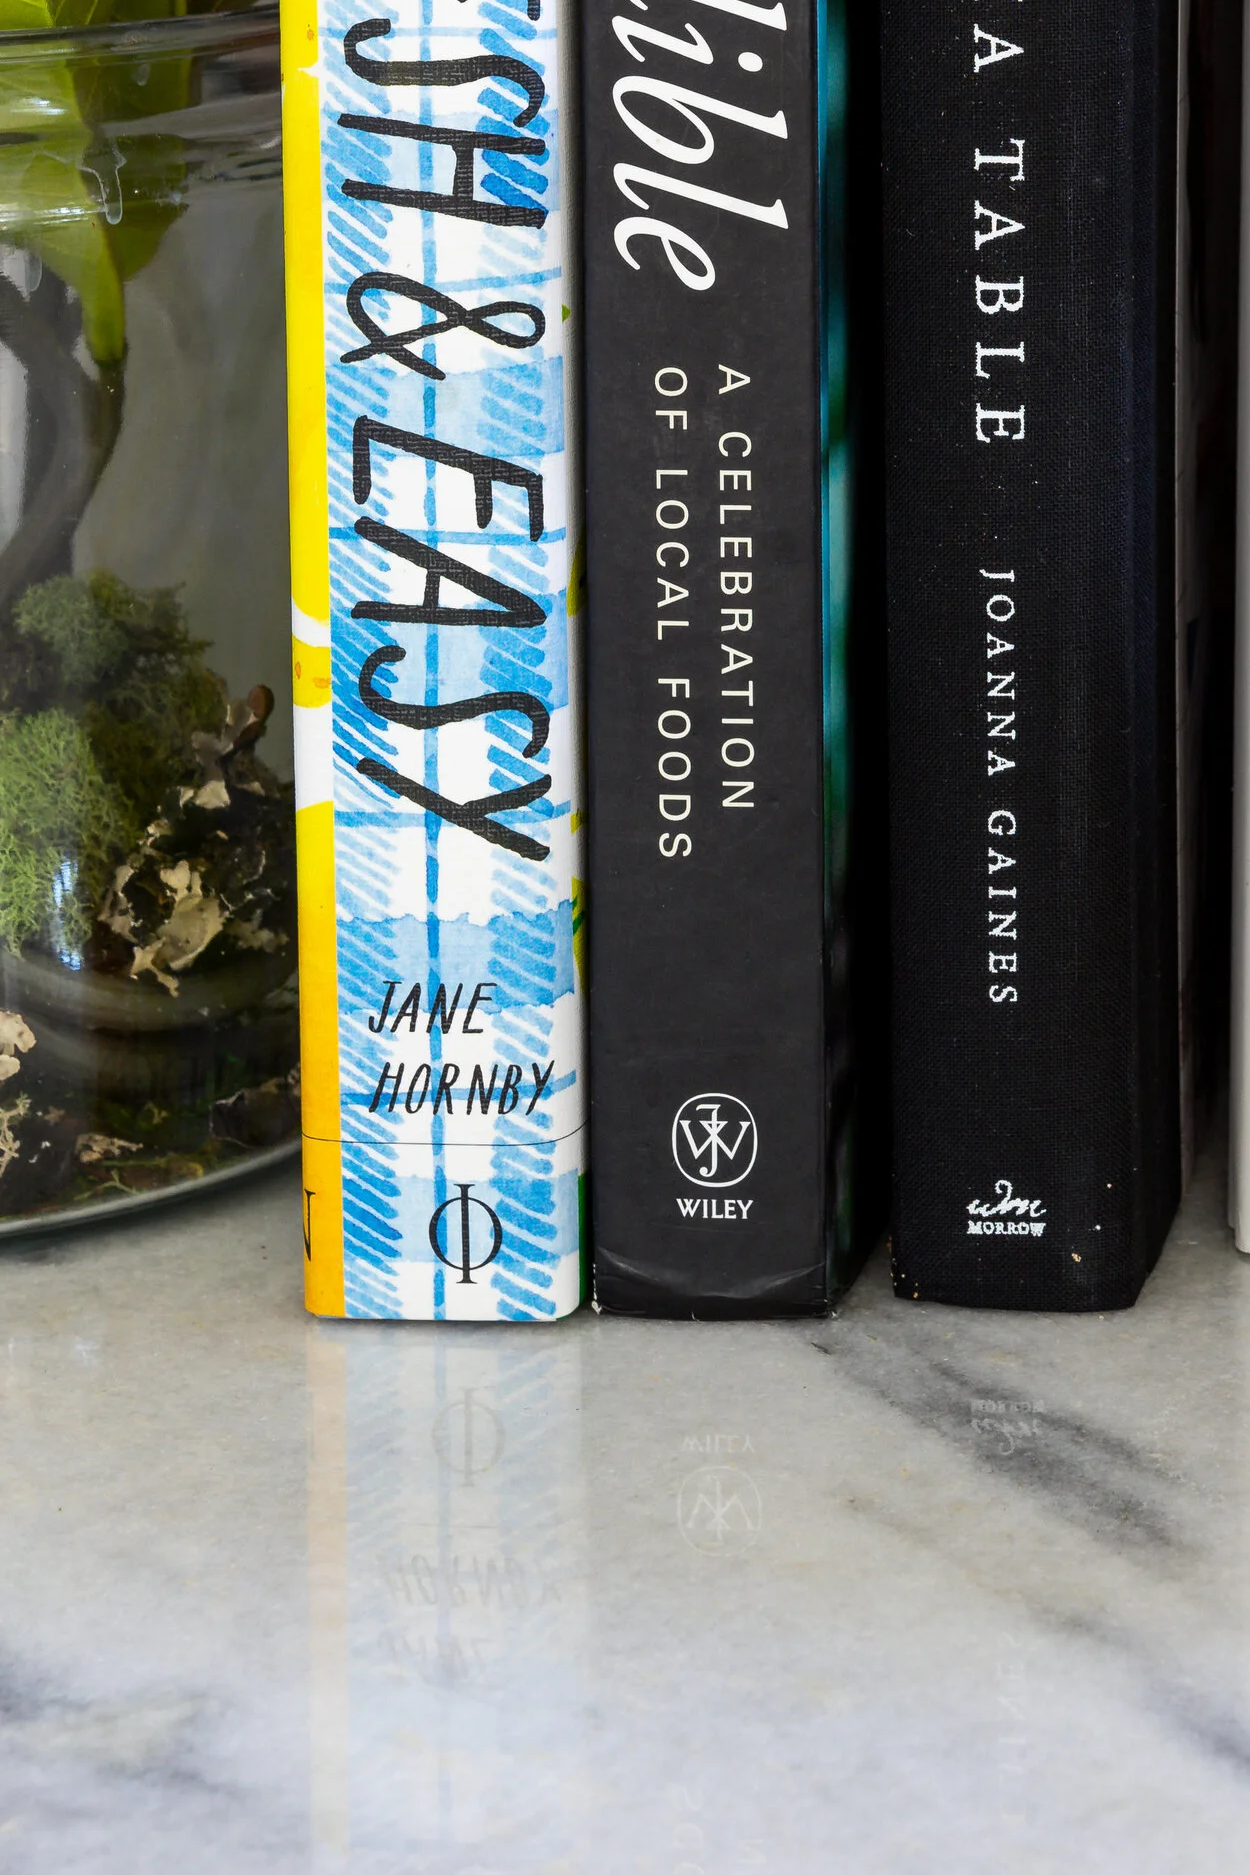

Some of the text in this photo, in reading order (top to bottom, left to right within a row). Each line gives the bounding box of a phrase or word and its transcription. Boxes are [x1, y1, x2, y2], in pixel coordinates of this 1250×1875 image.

[339, 272, 544, 379] &
[973, 138, 1024, 442] TABLE
[350, 414, 551, 860] EASY
[653, 366, 691, 856] OF LOCAL FOODS
[718, 364, 754, 808] A CELEBRATION
[979, 568, 1016, 1002] JOANNA GAINES
[368, 980, 497, 1033] JANE
[368, 1060, 554, 1114] HORNBY
[676, 1198, 752, 1219] WILEY
[966, 1220, 1044, 1235] MORROW
